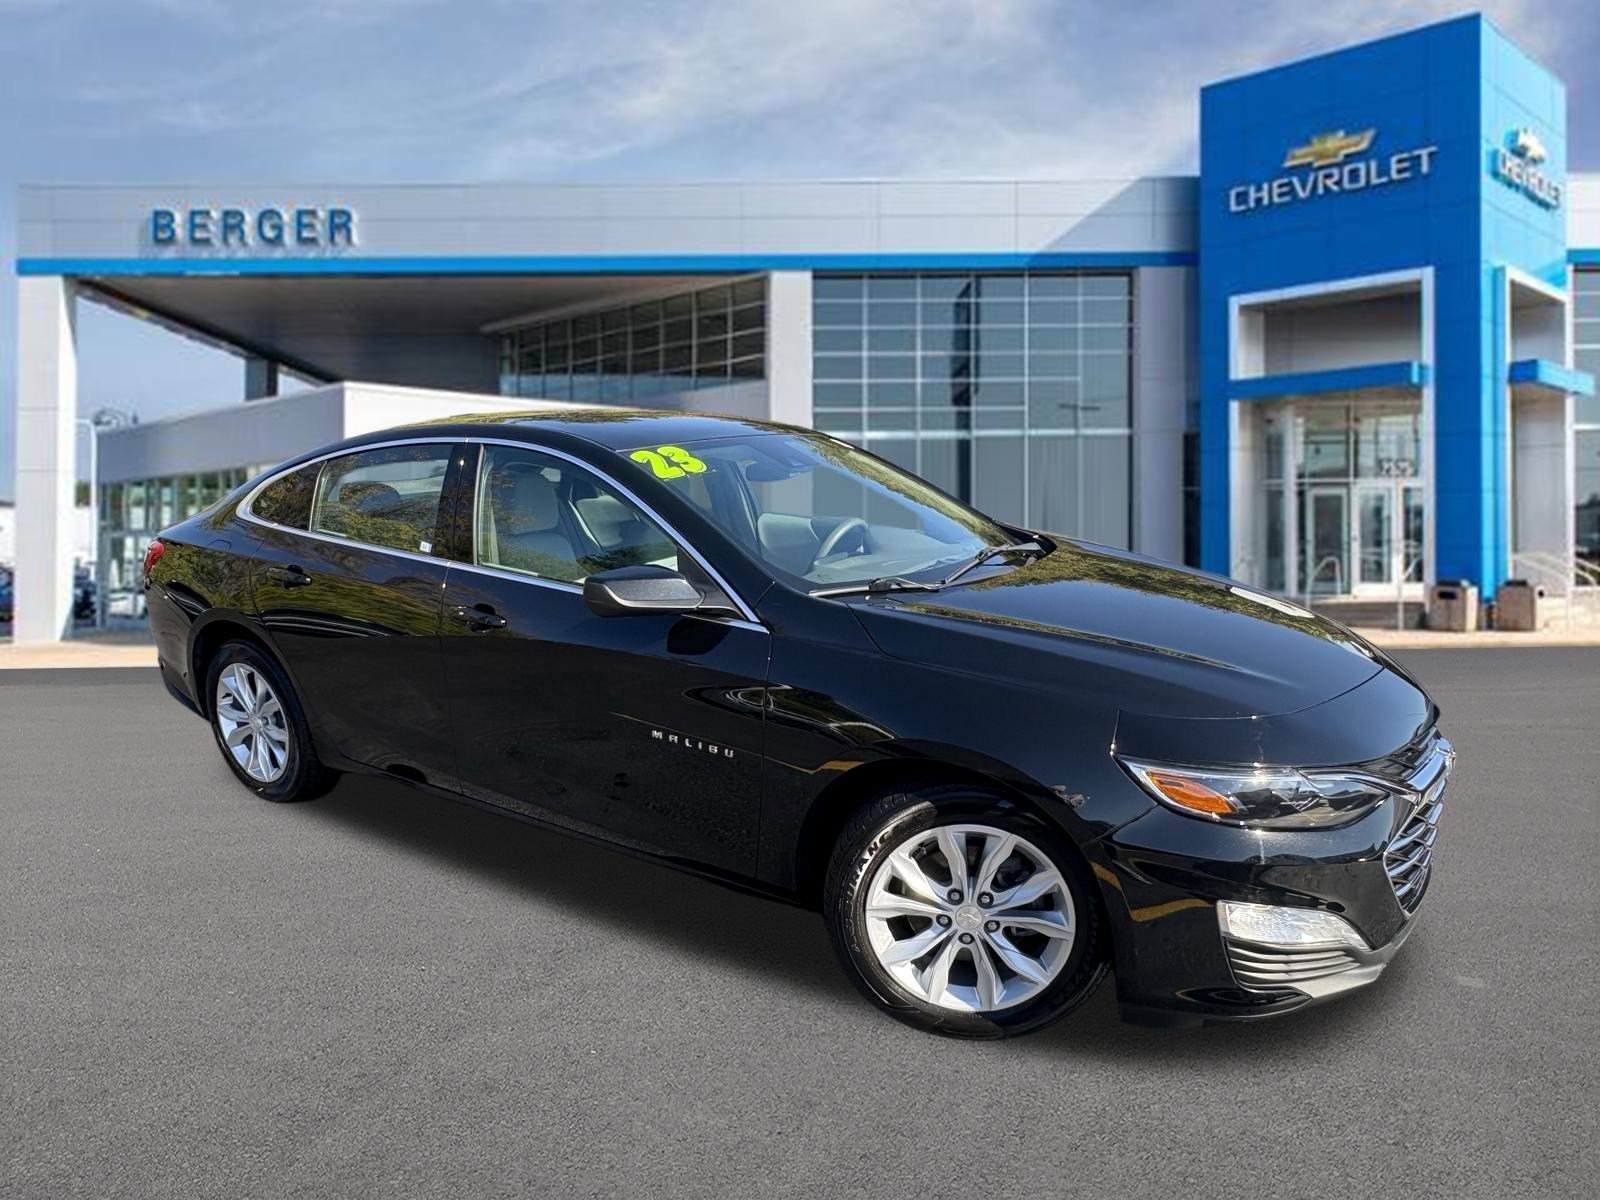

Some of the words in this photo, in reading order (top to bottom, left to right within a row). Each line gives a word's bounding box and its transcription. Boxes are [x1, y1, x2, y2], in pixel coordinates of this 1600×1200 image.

[1229, 146, 1438, 213] CHEVROLET
[152, 208, 356, 245] BERGER
[630, 445, 708, 479] 23
[651, 730, 734, 758] MALIBU
